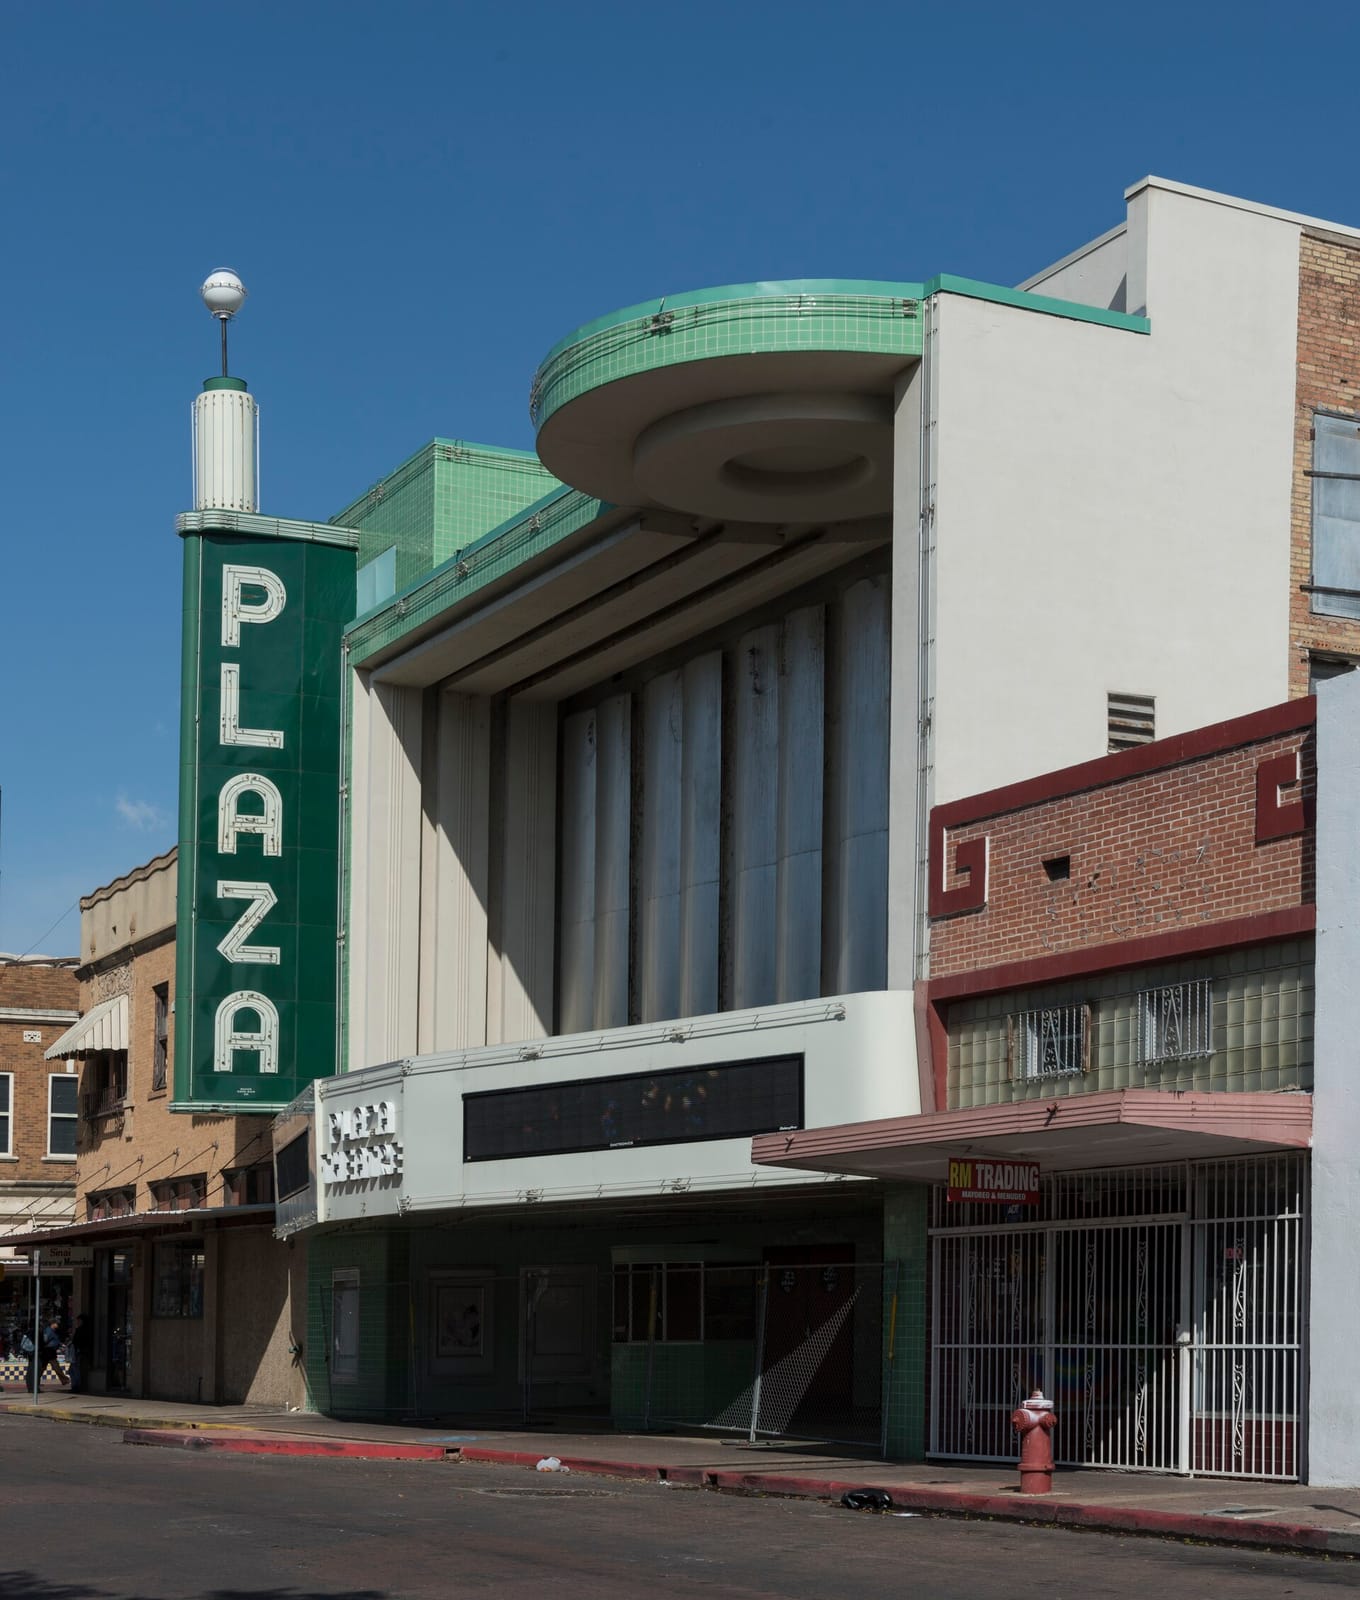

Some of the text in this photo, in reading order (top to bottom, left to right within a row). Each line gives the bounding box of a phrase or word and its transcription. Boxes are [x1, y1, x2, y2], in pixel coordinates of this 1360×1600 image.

[213, 563, 287, 1074] PLAZA
[950, 1162, 1039, 1192] RM TRADING
